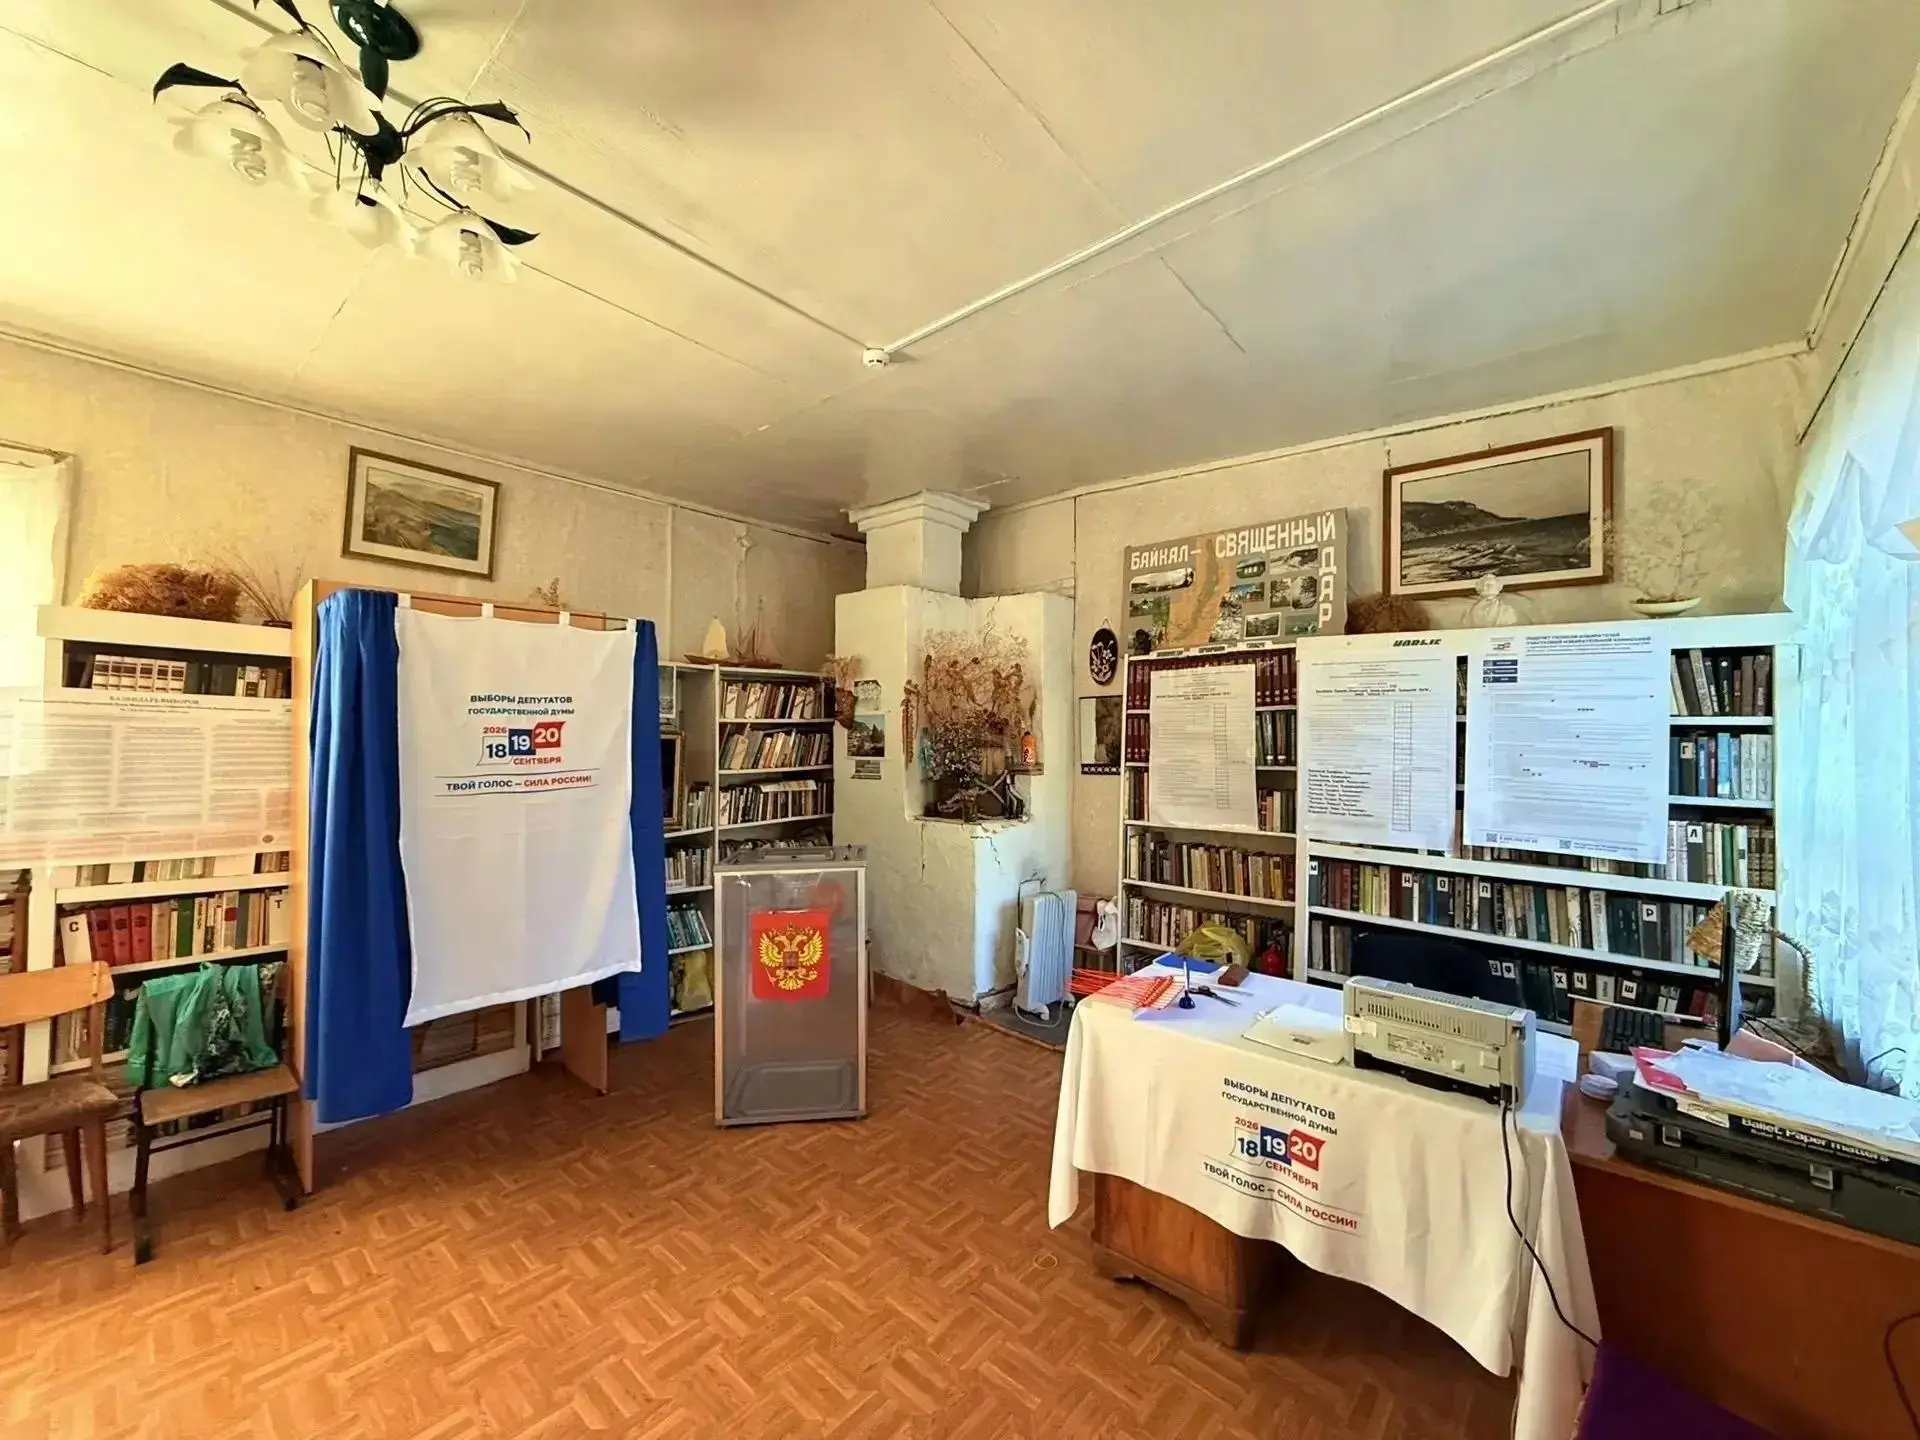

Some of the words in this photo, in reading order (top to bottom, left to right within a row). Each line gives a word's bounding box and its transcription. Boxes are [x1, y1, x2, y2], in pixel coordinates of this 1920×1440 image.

[1131, 544, 1188, 570] БАЙКАЛ
[1215, 512, 1336, 558] СВЯЩЕННЫЙ
[468, 707, 549, 716] ГОСУДАРСТВЕННОЙ
[550, 708, 575, 716] ДУМЫ
[470, 695, 516, 703] ВЫБОРЫ
[517, 695, 573, 704] ДЕПУТАТОВ
[483, 726, 507, 734] 2026
[486, 743, 507, 758] 18
[511, 735, 531, 750] 19
[535, 728, 559, 743] 20
[513, 756, 561, 765] СЕНТЯБРЯ
[446, 781, 476, 791] ТВОЙ
[478, 780, 513, 789] ГОЛОС
[524, 778, 549, 787] СИЛА
[551, 775, 592, 785] РОССИИ!
[1224, 1077, 1269, 1098] ВЫБОРЫ
[1271, 1092, 1336, 1120] ДЕПУТАТОВ
[1222, 1091, 1307, 1124] ГОСУДАРСТВЕННОЙ
[1308, 1121, 1338, 1136] ДУМЫ
[1235, 1116, 1259, 1130] 2026
[1237, 1137, 1258, 1158] 18
[1263, 1135, 1285, 1156] 19
[1290, 1136, 1317, 1162] 20
[1265, 1160, 1319, 1191] СЕНТЯБРЯ
[1203, 1162, 1229, 1180] ТВОЙ
[1231, 1175, 1265, 1193] ГОЛОС
[1277, 1188, 1303, 1210] СИЛА
[1305, 1206, 1358, 1229] РОССИИ!
